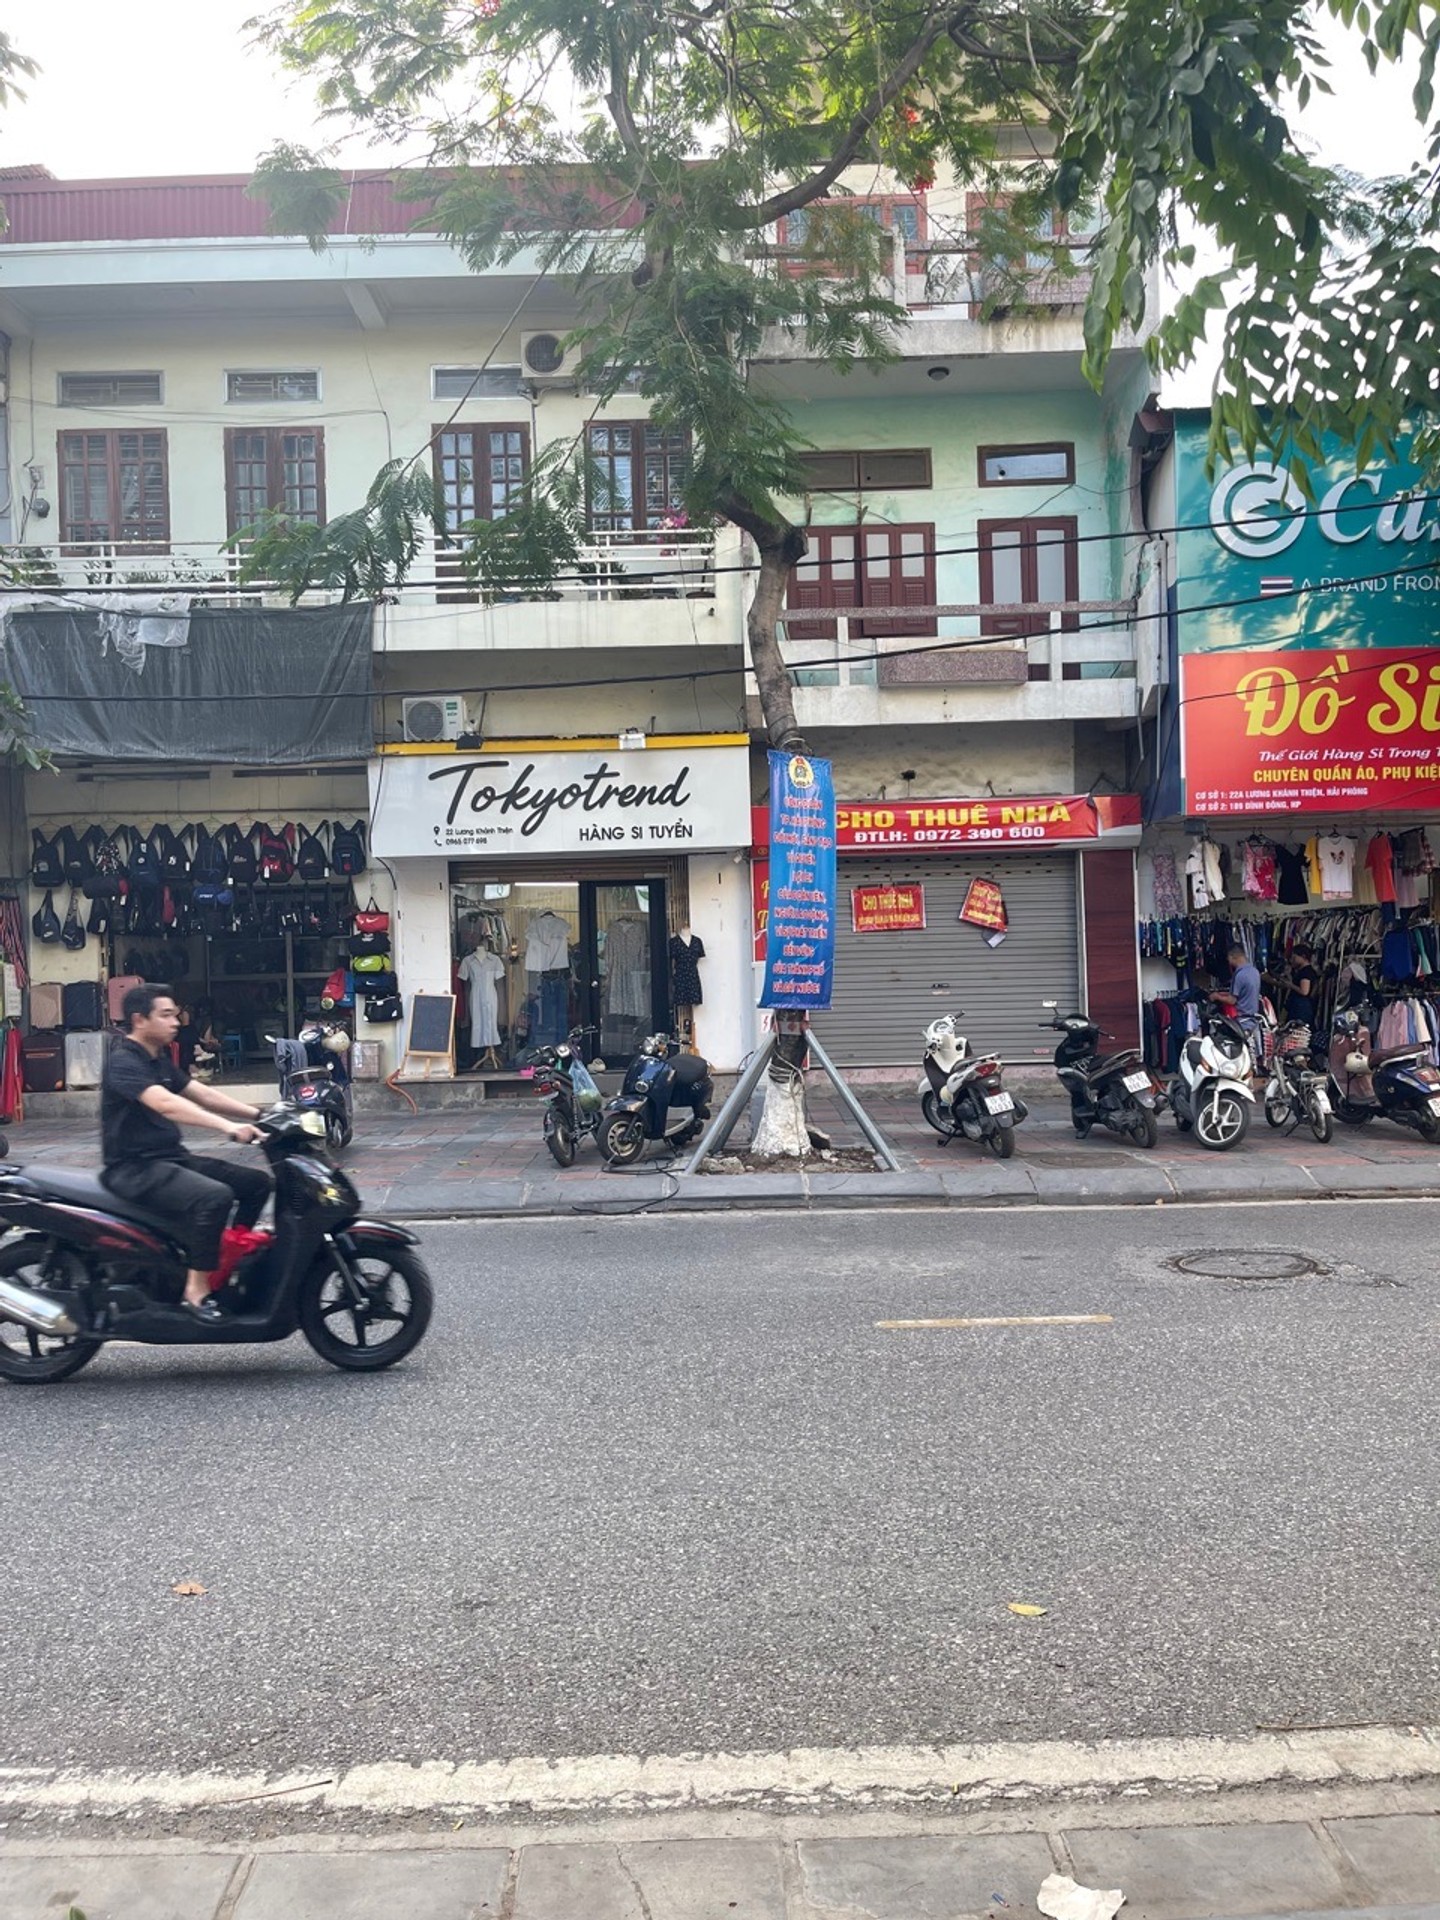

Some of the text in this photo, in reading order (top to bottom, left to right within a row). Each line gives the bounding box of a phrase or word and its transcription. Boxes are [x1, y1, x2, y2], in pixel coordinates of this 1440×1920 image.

[1316, 472, 1440, 544] Ca
[1320, 576, 1388, 592] BRAND
[1235, 655, 1356, 737] Đồ
[1259, 748, 1287, 762] Thế
[1288, 747, 1319, 761] Giới
[1323, 746, 1364, 764] Hàng
[1368, 746, 1384, 760] Si
[1388, 745, 1431, 760] Trong
[1253, 766, 1309, 783] CHUYÊN
[1382, 766, 1411, 781] PHỤ
[1415, 763, 1440, 781] KIỆ
[428, 760, 690, 837] Tokyotrend
[1272, 788, 1299, 798] KHÁNH
[836, 801, 1071, 830] CHO THUÊ NHÀ
[579, 817, 693, 841] HÀNG SI TUYỂN
[854, 826, 1045, 844] ĐTLH: 0972 390 600
